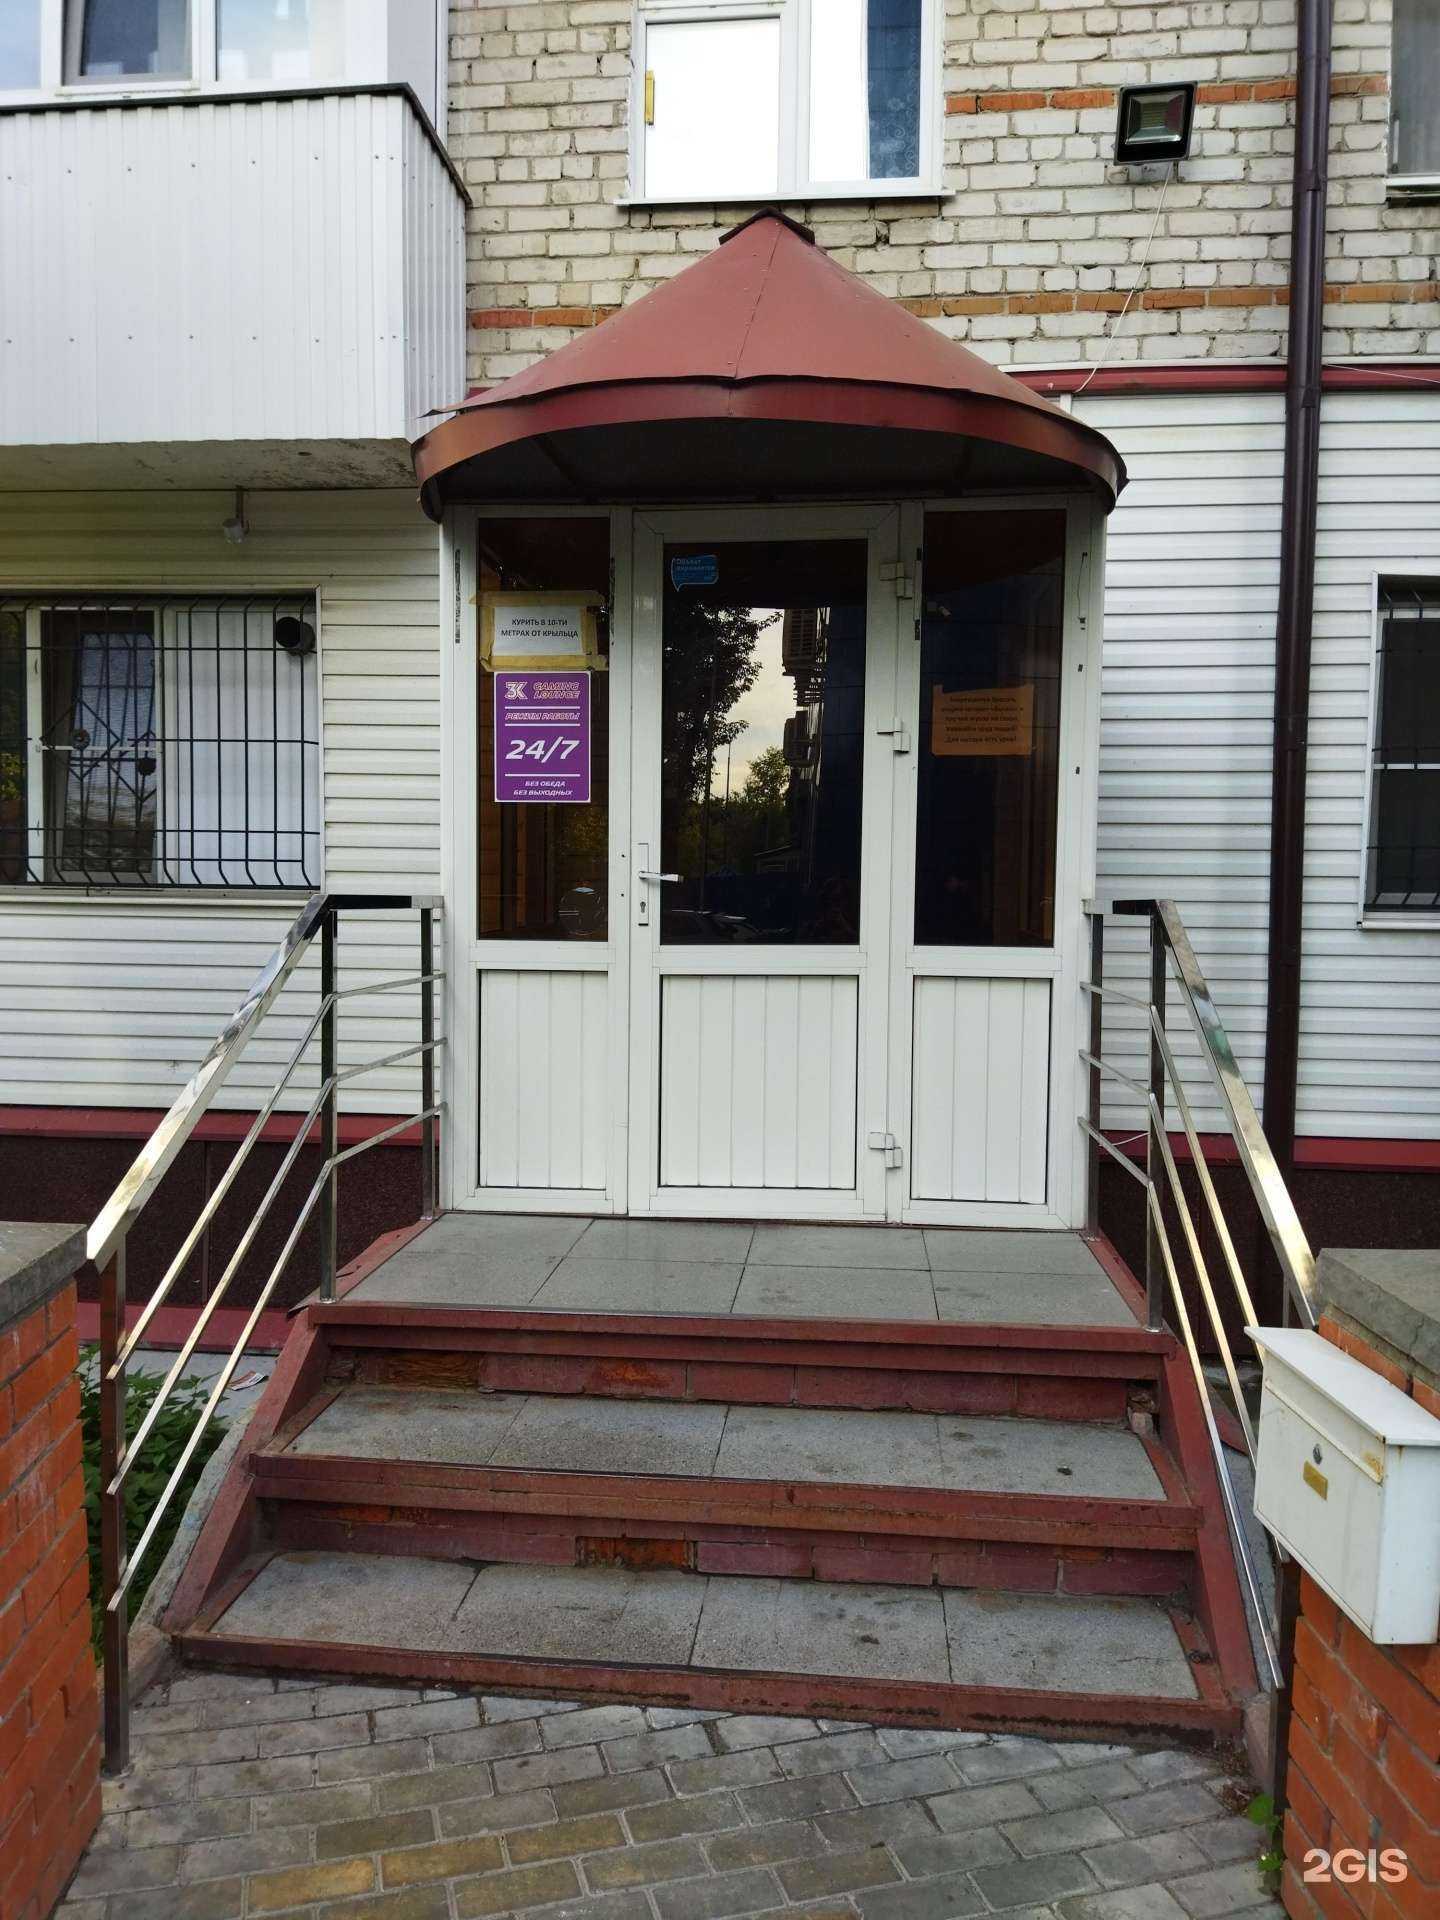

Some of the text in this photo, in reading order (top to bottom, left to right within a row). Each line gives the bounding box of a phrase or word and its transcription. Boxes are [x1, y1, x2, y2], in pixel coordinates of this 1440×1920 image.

[501, 629, 578, 638] МЕТРАХ ОТ КРЫЛЬЦА
[533, 681, 580, 690] GAMING
[533, 690, 580, 699] LOUNGE
[505, 736, 580, 763] 24/7
